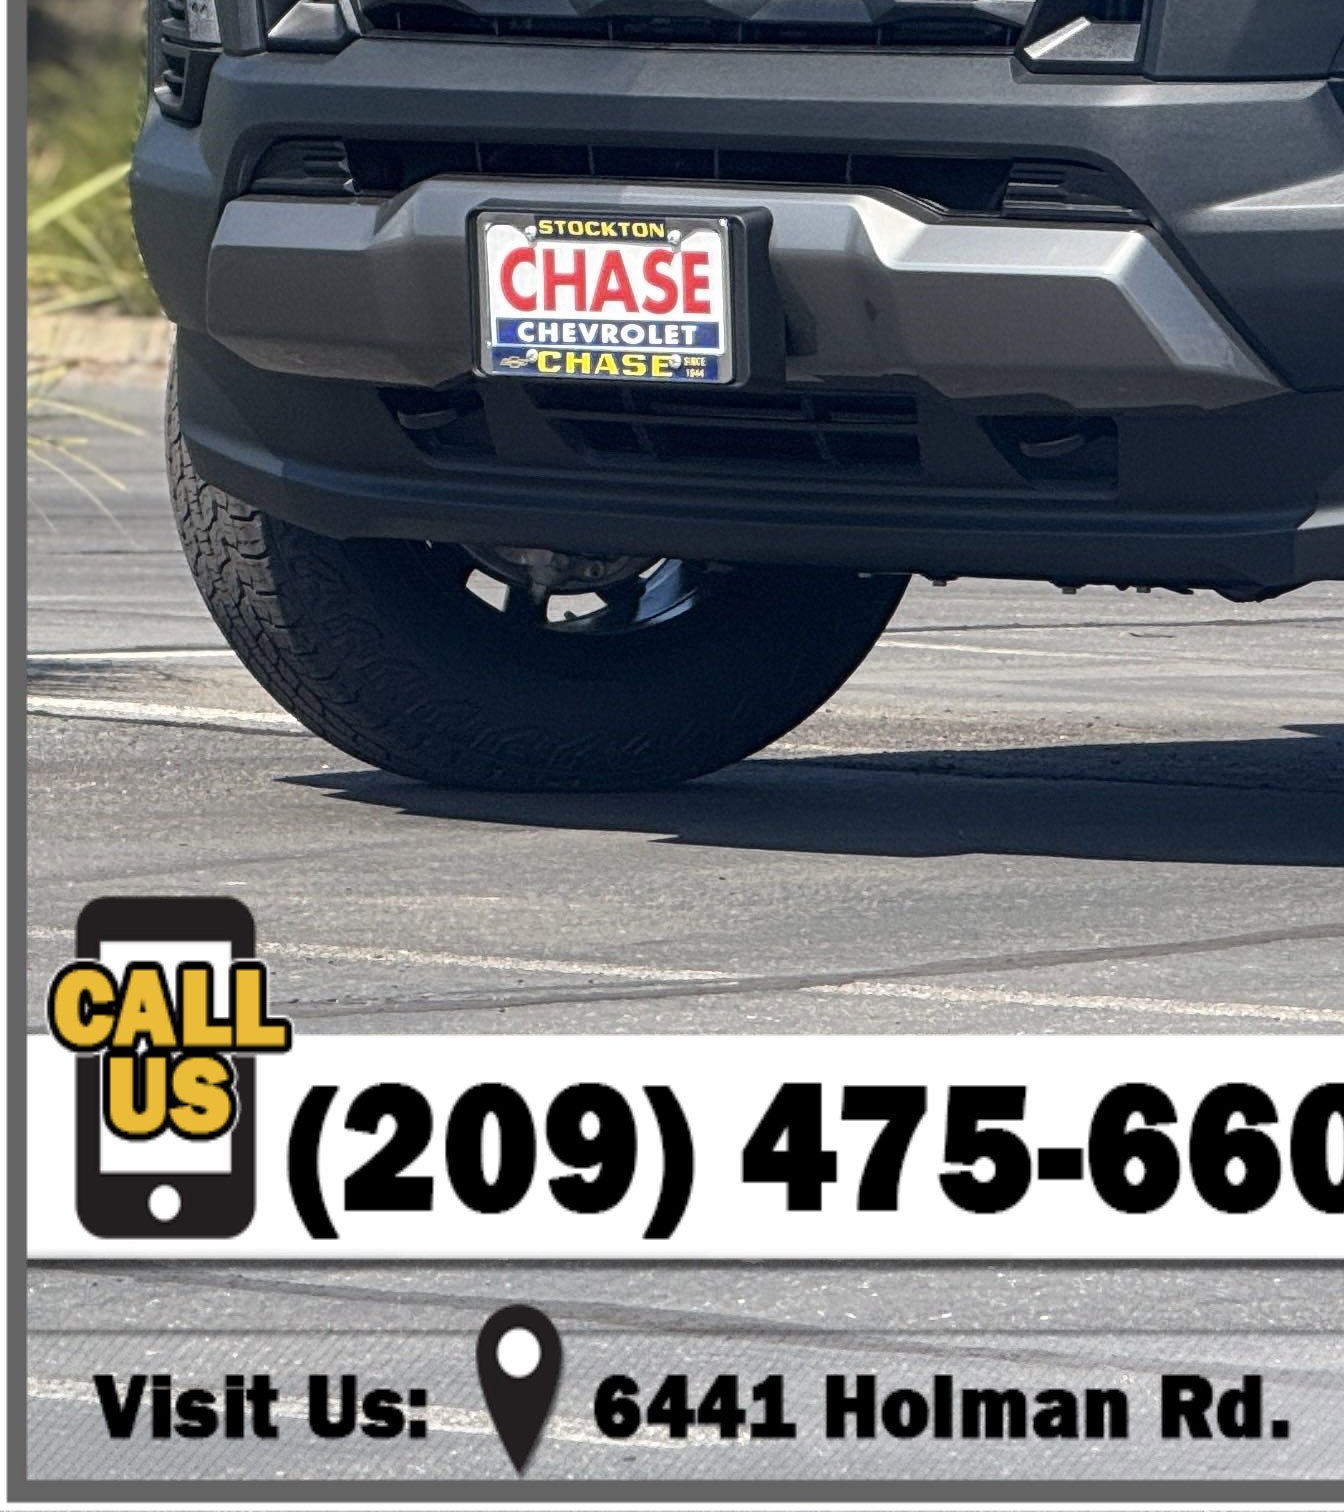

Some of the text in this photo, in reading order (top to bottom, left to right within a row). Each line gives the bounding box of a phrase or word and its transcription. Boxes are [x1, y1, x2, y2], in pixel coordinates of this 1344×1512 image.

[538, 219, 665, 238] STOCKTON
[500, 247, 711, 314] CHASE
[518, 322, 698, 345] CHEVROLET
[537, 351, 674, 377] CHASE
